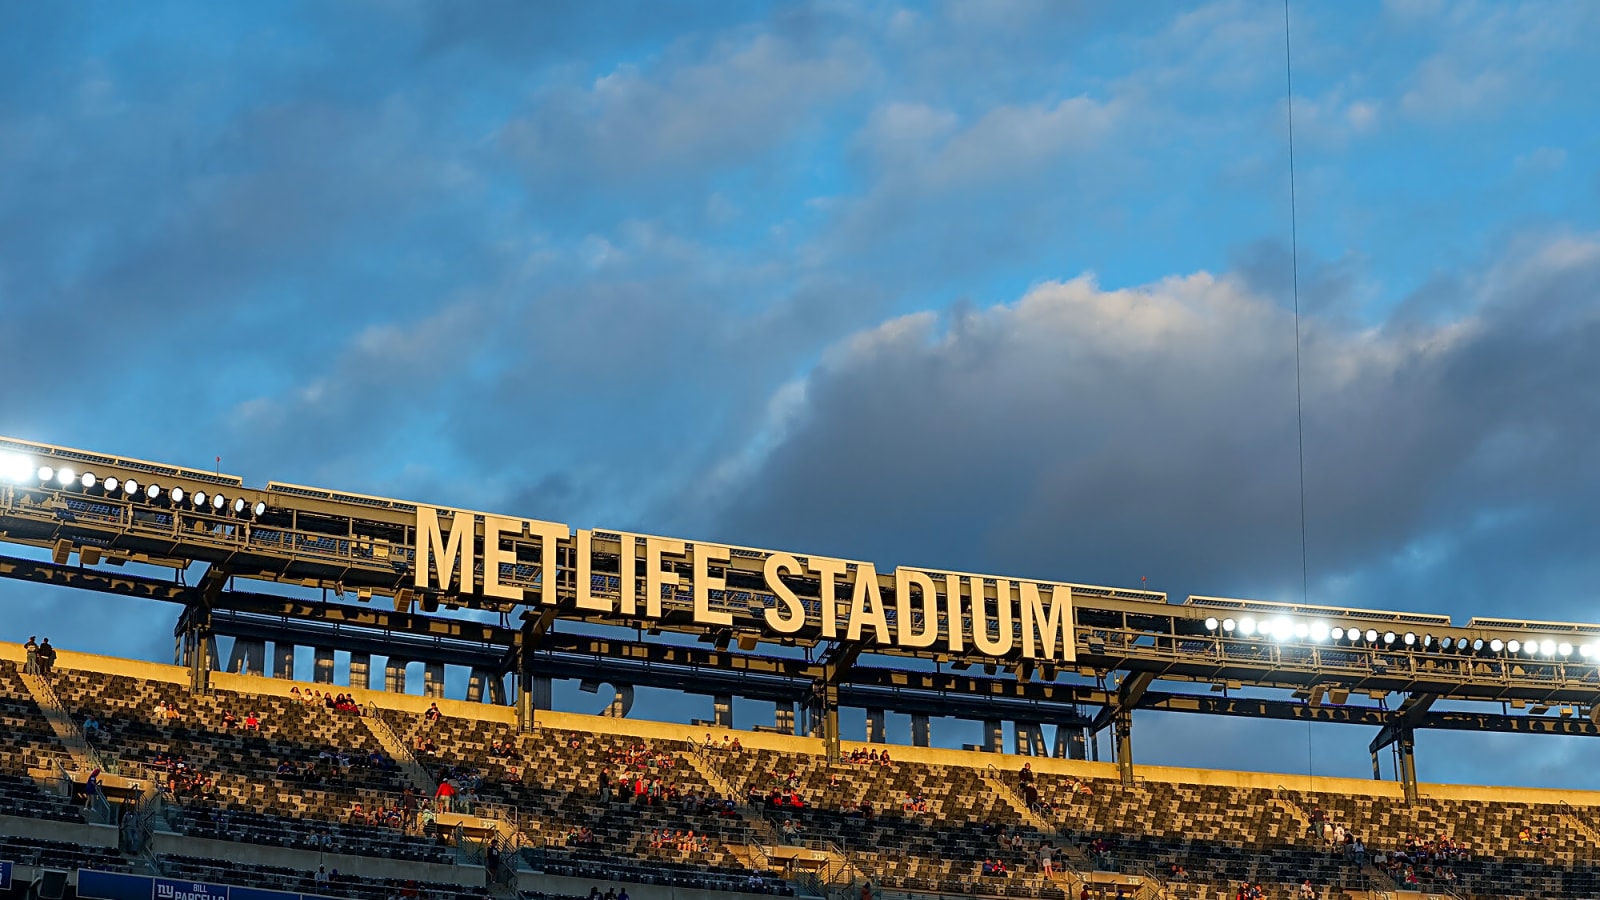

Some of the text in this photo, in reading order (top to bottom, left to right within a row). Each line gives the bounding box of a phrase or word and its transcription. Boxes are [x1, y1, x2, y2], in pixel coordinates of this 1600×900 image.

[415, 506, 1077, 662] METLIFE STADIUM
[193, 883, 208, 893] BILL
